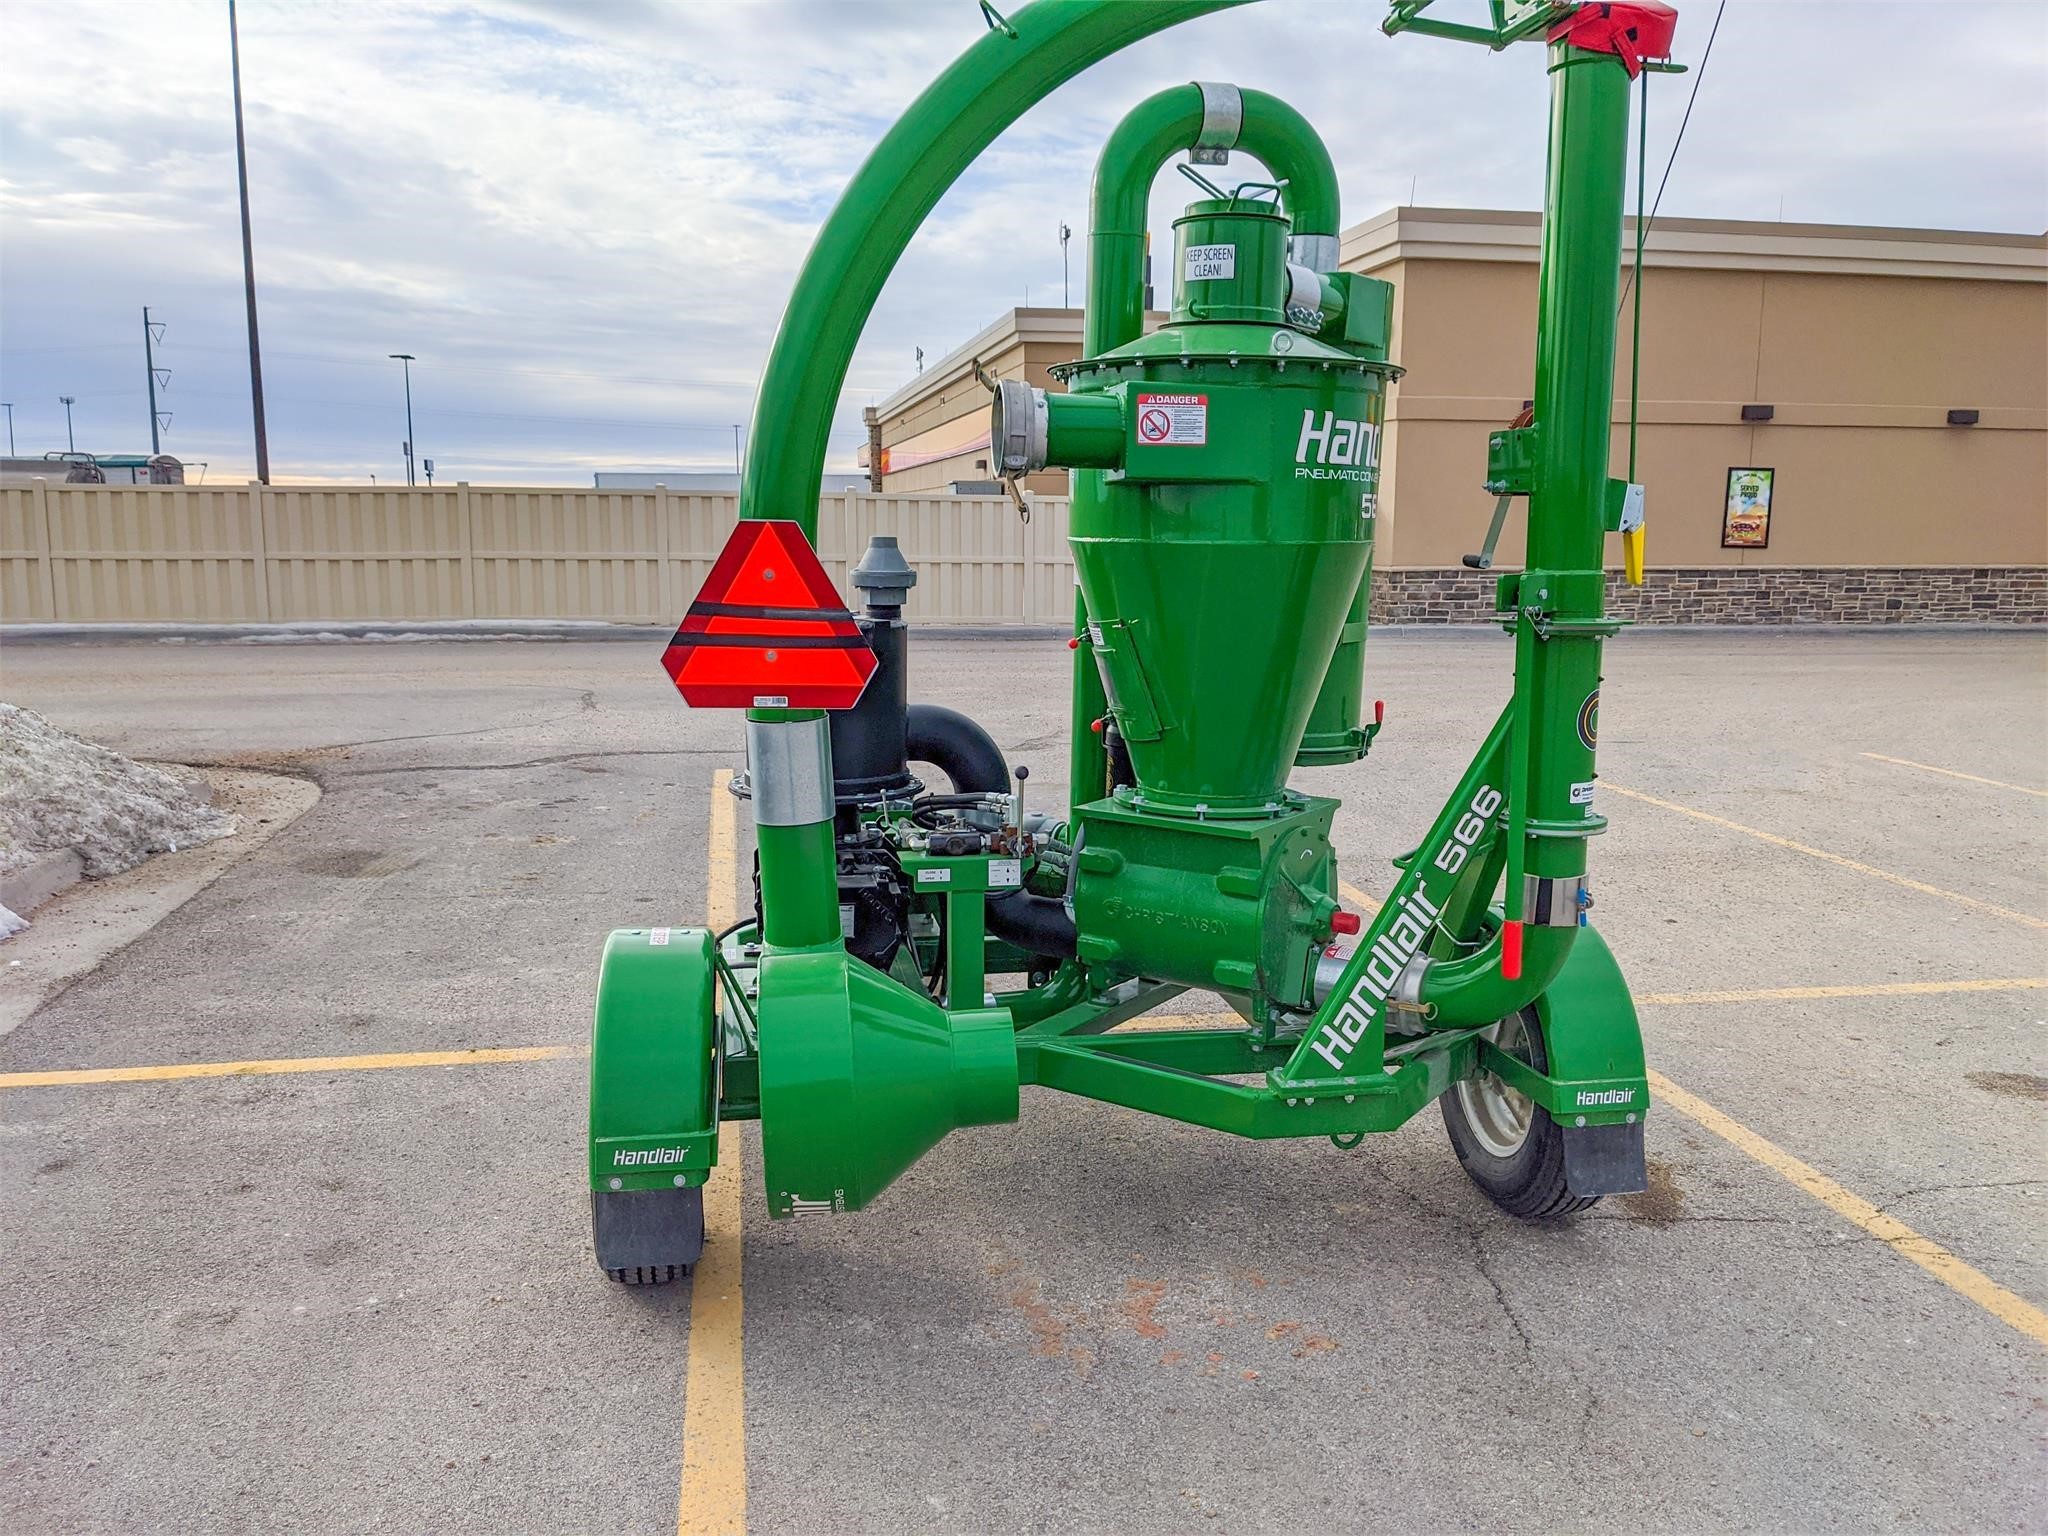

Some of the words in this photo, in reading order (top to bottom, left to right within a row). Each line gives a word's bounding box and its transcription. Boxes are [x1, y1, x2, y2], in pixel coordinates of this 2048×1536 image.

[1186, 248, 1203, 262] KEEP
[1203, 247, 1234, 261] SCREEN
[1193, 263, 1222, 277] CLEAN!
[1156, 395, 1199, 405] DANGER
[1295, 467, 1360, 481] PNEUMATIC
[1740, 484, 1759, 492] SERVED
[1740, 491, 1758, 499] PROUD
[1311, 879, 1440, 1071] Handlair
[1433, 784, 1503, 875] 566
[1576, 1087, 1636, 1106] Handlair
[613, 1145, 690, 1166] Handlair
